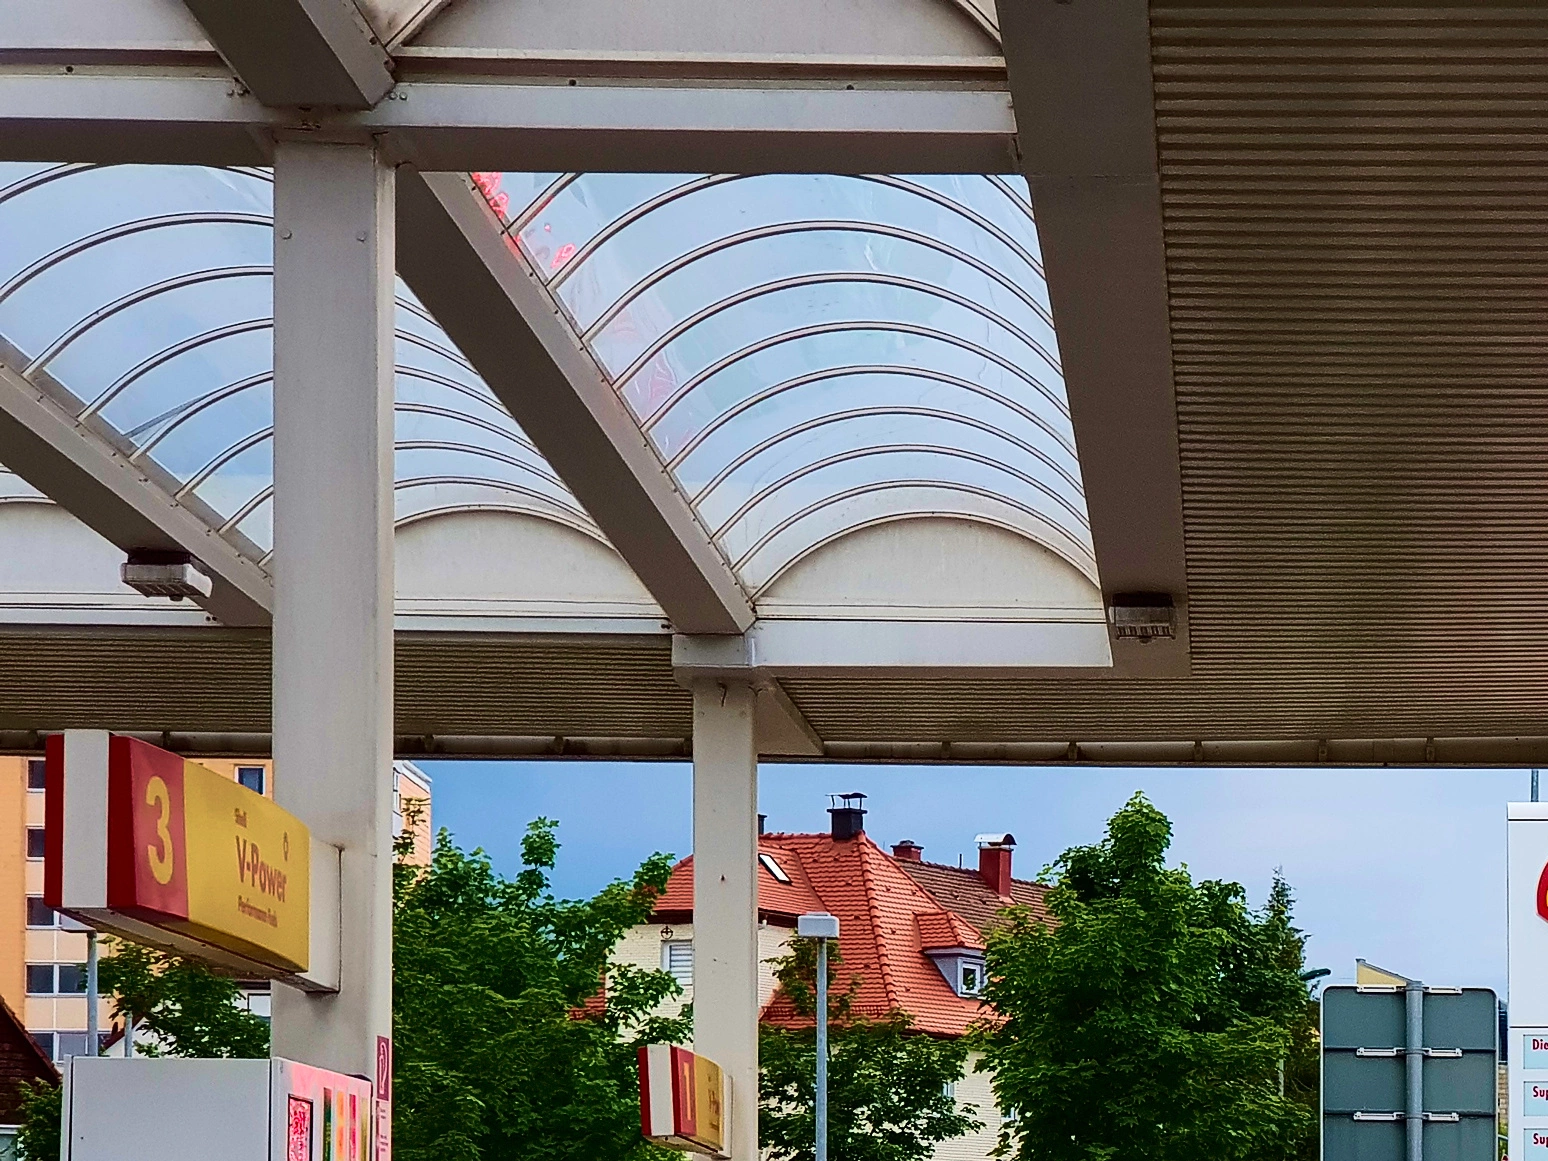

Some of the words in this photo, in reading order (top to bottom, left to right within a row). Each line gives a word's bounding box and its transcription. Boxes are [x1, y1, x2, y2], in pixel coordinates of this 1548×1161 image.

[145, 776, 174, 885] 3
[235, 835, 287, 903] V-Power
[683, 1062, 692, 1120] 1
